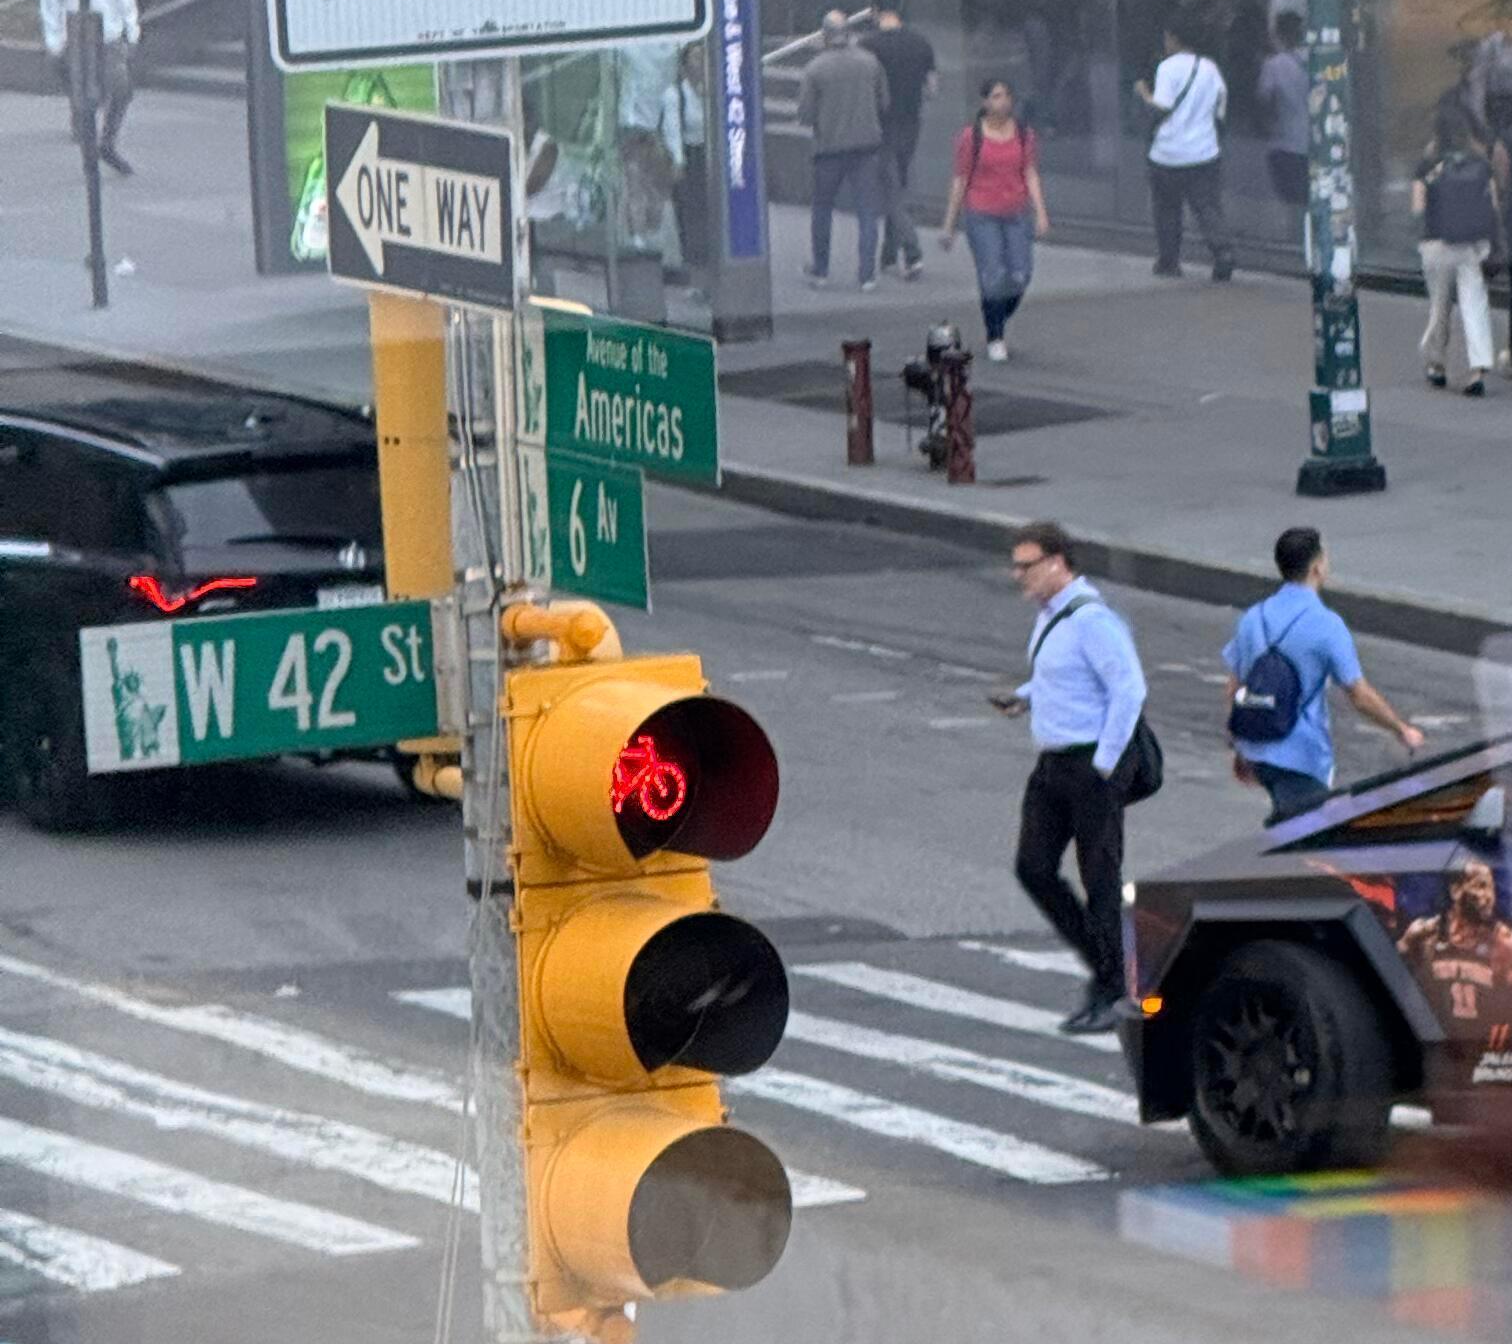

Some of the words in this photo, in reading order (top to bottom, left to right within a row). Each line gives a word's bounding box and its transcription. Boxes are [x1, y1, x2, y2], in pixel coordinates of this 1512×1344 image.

[356, 163, 413, 239] ONE
[436, 176, 491, 254] WAY
[586, 327, 628, 372] Avenue
[631, 336, 644, 375] of
[647, 339, 669, 380] the
[573, 370, 685, 461] Americas
[568, 477, 587, 577] 6
[596, 479, 619, 545] Av
[178, 638, 237, 743] W
[266, 627, 358, 733] 42
[380, 623, 426, 687] St
